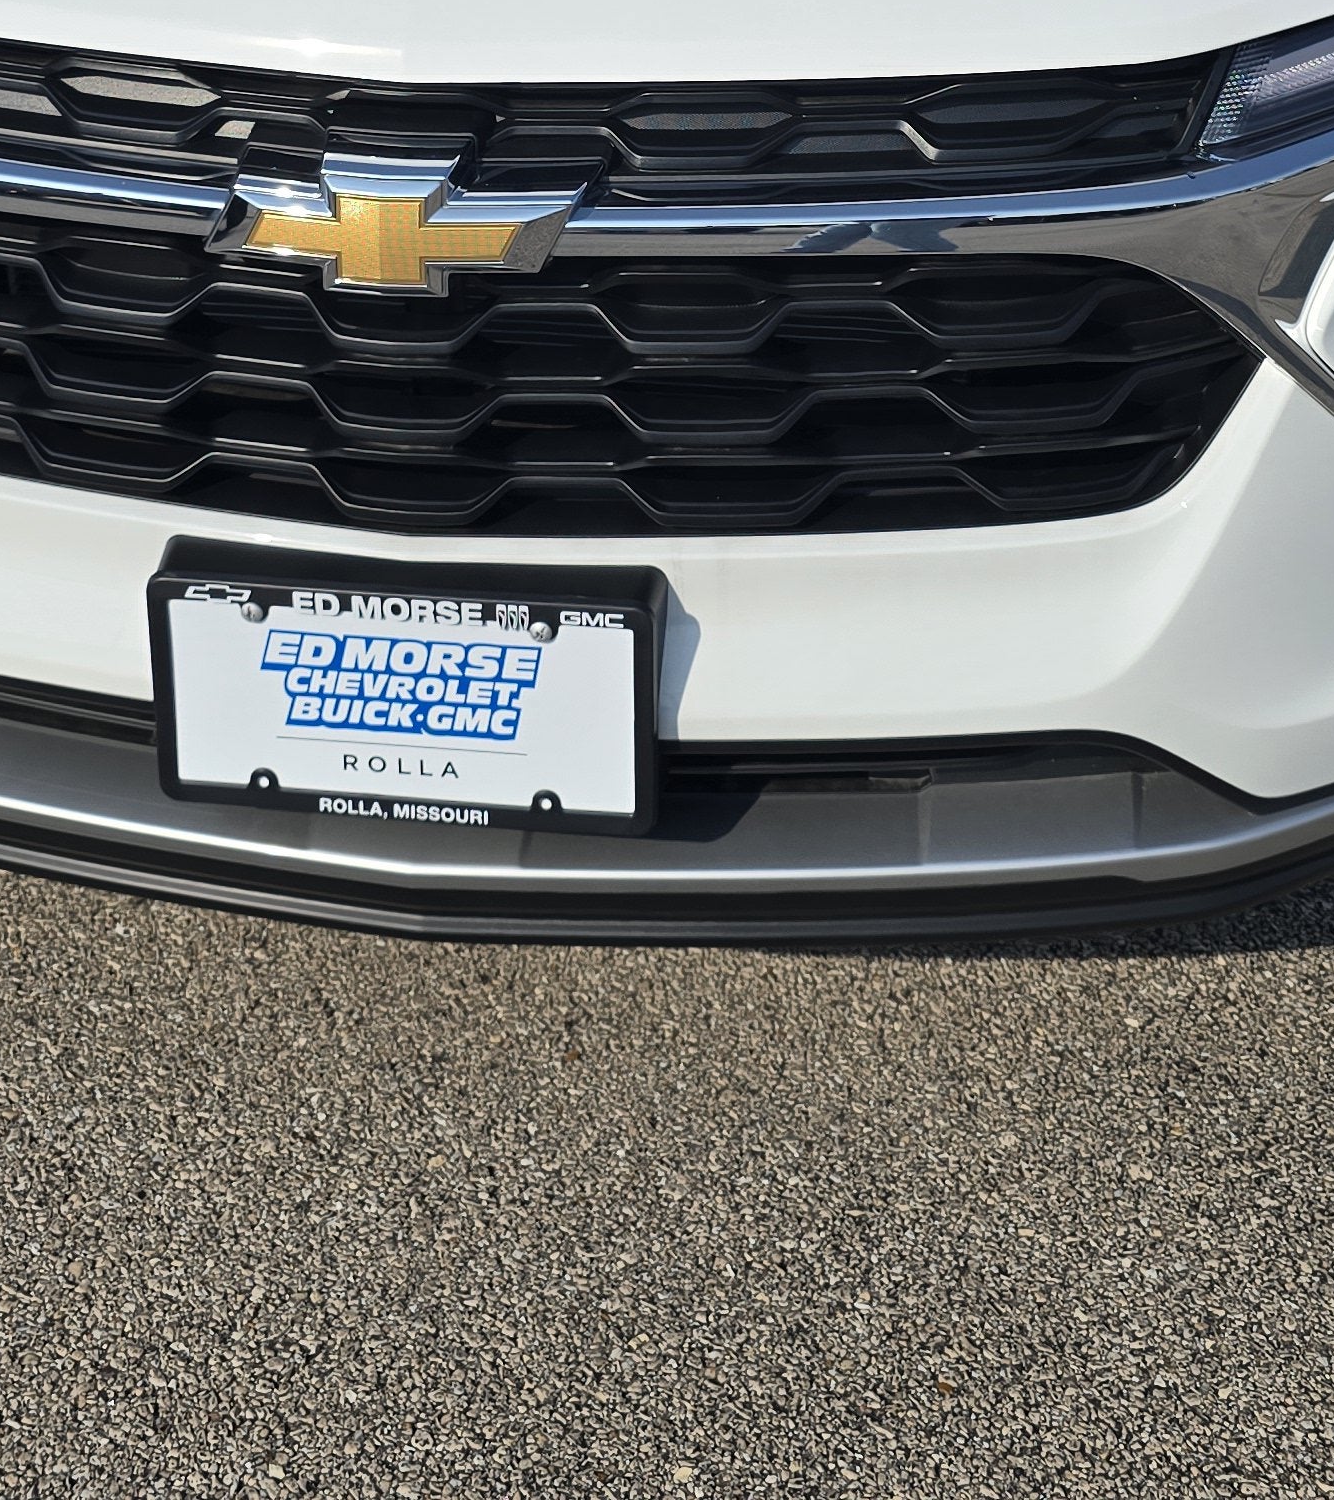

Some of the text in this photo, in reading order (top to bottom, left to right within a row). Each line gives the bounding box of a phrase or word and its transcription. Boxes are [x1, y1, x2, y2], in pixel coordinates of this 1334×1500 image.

[291, 591, 483, 626] ED MORSE
[559, 610, 625, 629] GMC
[264, 631, 540, 681] ED MORSE
[343, 754, 459, 778] ROLLA
[318, 797, 489, 826] ROLLA, MISSOURI
